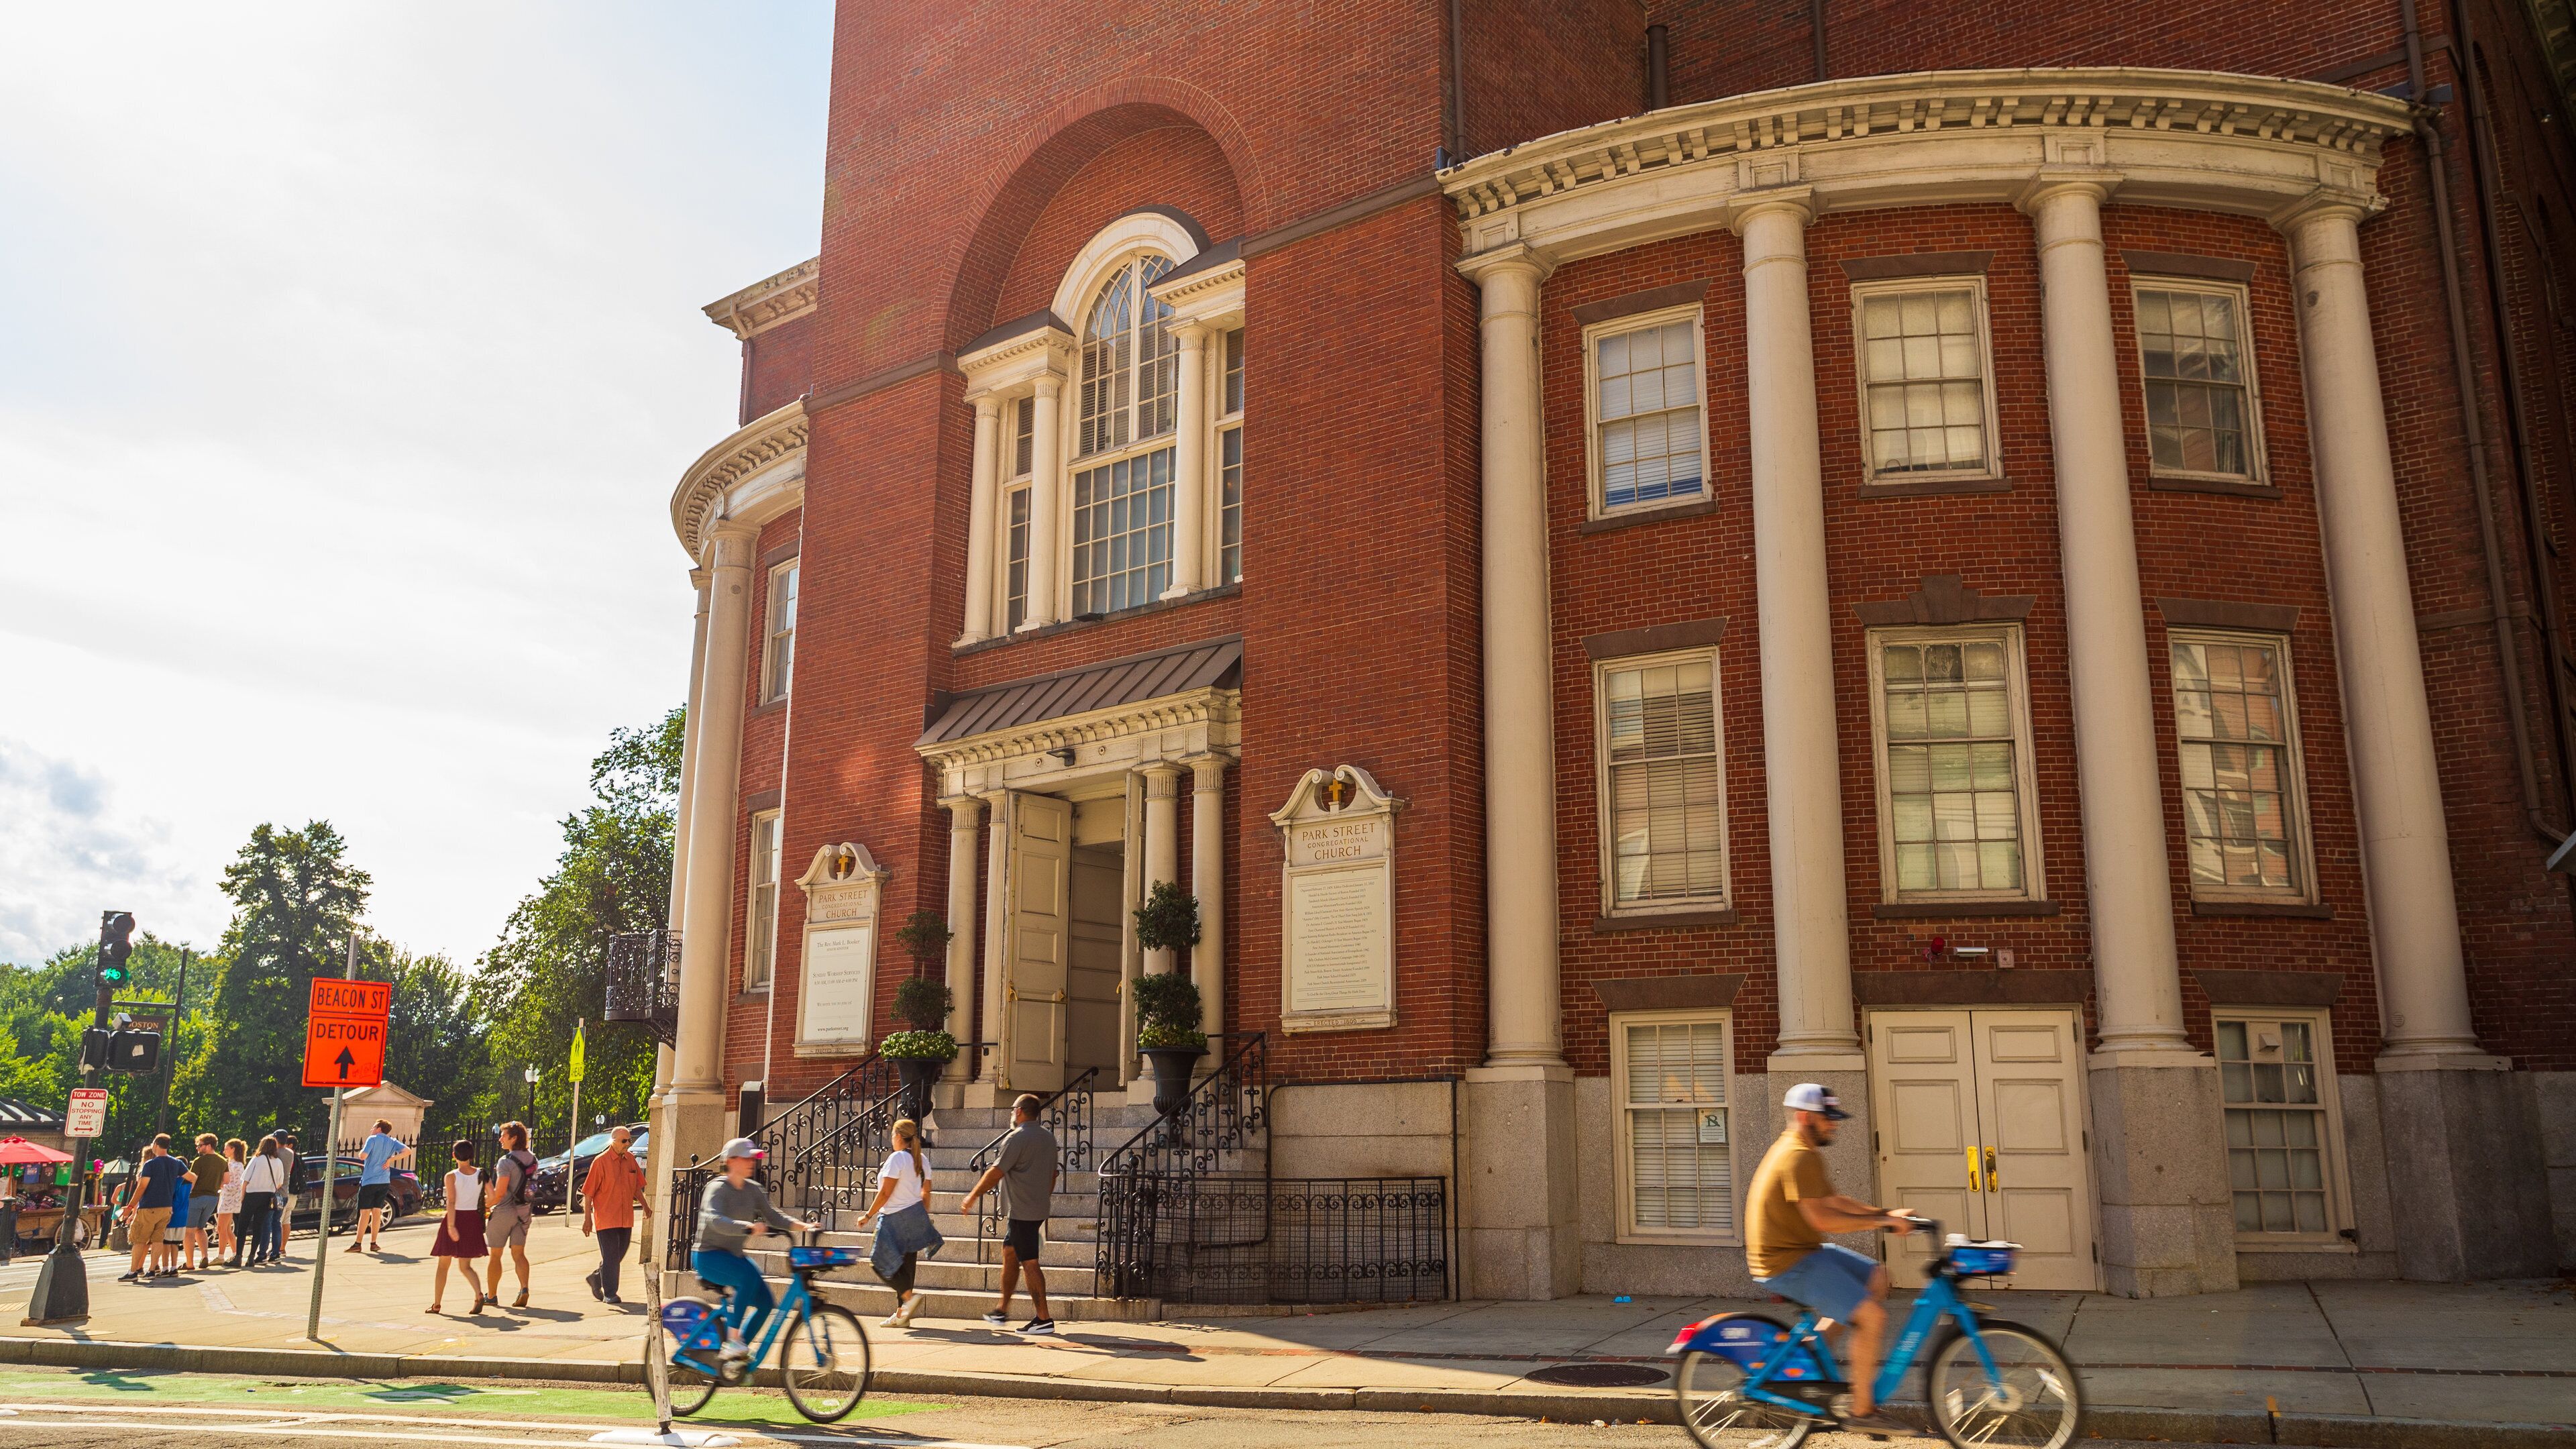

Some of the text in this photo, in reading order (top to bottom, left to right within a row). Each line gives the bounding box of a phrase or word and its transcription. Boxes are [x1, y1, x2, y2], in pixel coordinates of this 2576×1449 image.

[1302, 822, 1375, 841] PARK STREET
[1307, 836, 1368, 849] CONGREGATIONAL
[1315, 845, 1360, 860] CHURCH
[818, 890, 867, 903] PARK STREET
[826, 908, 857, 918] CHURCH
[317, 987, 384, 1009] BEACON ST
[317, 1024, 378, 1040] DETOUR
